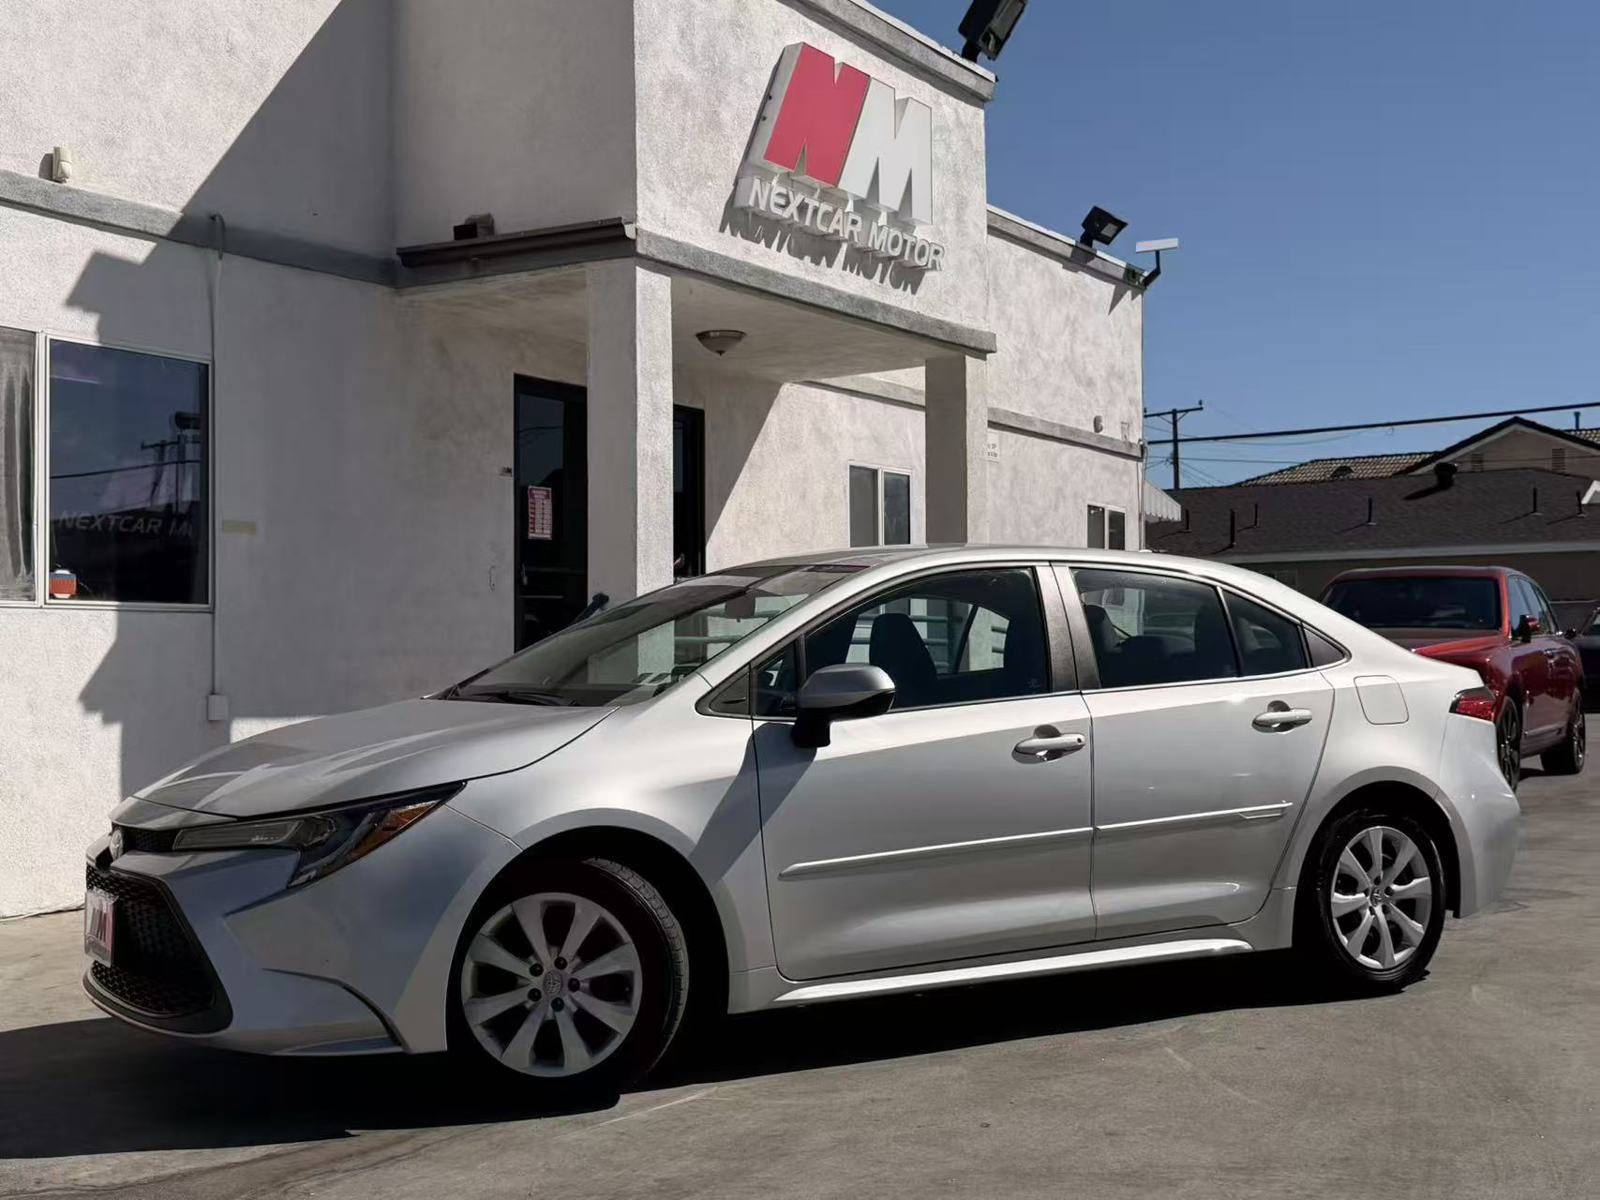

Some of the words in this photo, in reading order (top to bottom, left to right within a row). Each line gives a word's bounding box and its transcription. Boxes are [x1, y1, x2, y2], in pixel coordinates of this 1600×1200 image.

[748, 178, 862, 243] NEXTCAR
[868, 221, 945, 271] MOTOR
[57, 510, 162, 534] NEXTCAR
